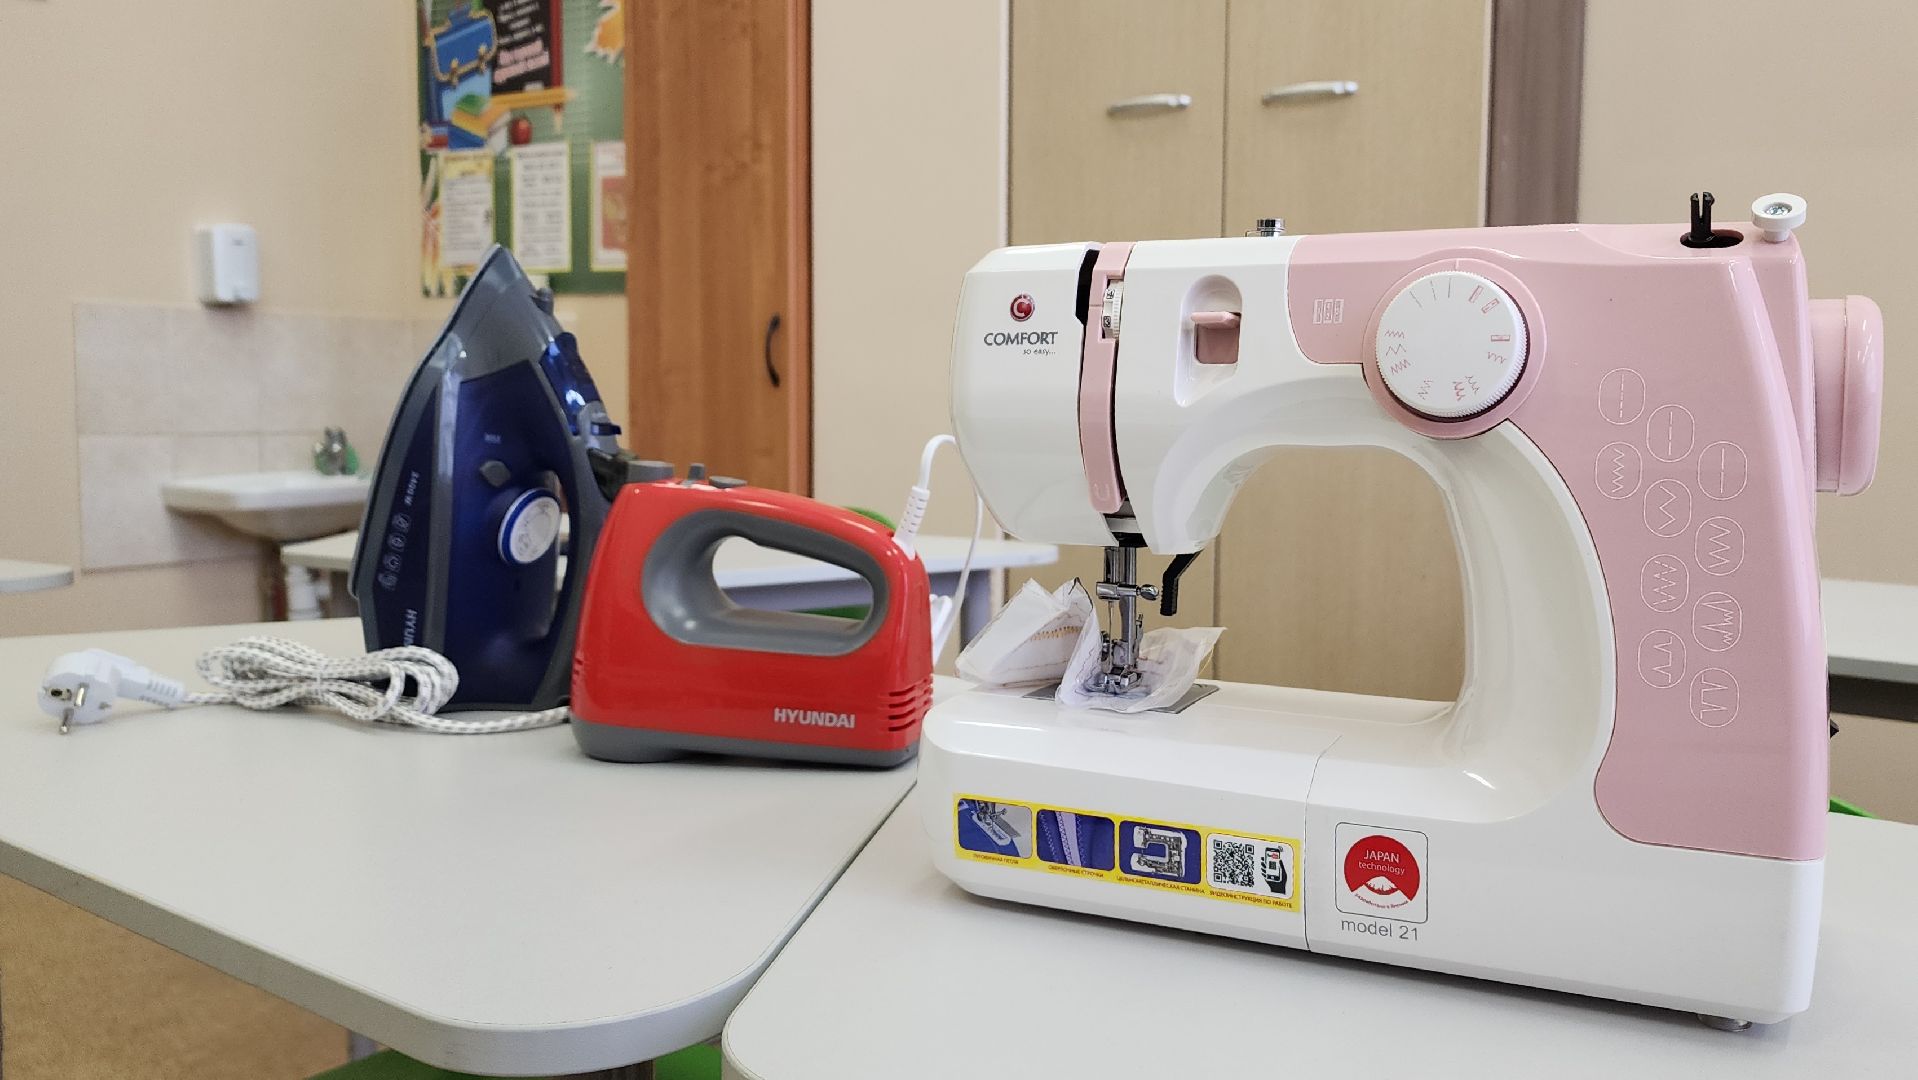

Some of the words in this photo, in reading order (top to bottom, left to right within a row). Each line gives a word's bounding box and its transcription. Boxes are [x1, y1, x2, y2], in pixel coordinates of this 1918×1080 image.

[983, 331, 1058, 346] COMFORT
[403, 608, 418, 646] HYUN
[774, 707, 855, 728] HYUNDAI
[1363, 849, 1399, 864] JAPAN
[1358, 860, 1405, 876] technology
[1272, 899, 1292, 909] РАБОТЕ
[1340, 919, 1393, 937] model
[1399, 925, 1418, 941] 21
